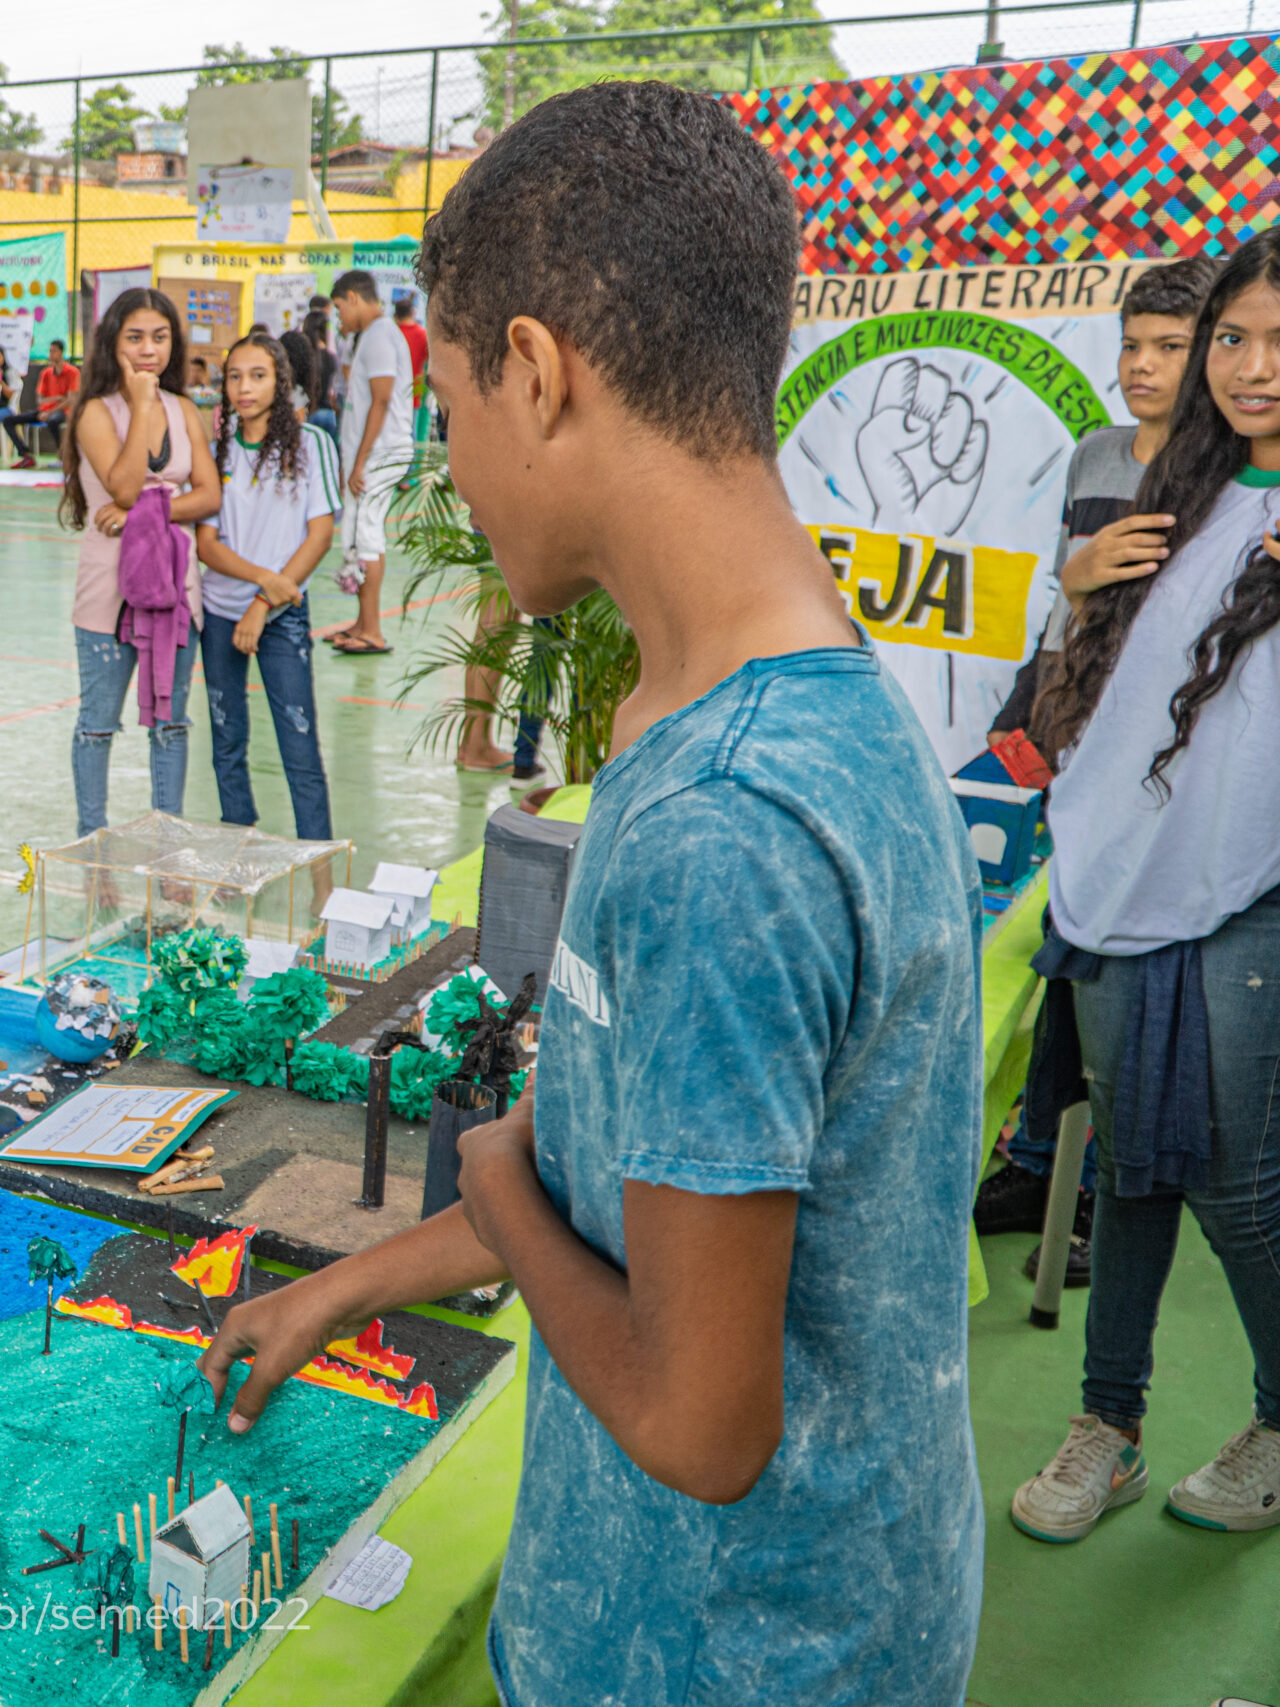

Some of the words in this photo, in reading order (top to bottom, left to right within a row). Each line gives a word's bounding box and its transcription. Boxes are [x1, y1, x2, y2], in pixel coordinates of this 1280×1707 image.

[185, 253, 193, 265] O
[201, 254, 252, 268] BRASIL
[260, 254, 286, 265] NAS
[299, 252, 341, 265] COPAS
[776, 342, 849, 441] STENCIA
[853, 330, 868, 364] E
[875, 316, 1025, 363] MULTIVOZES
[1023, 349, 1064, 392] DA
[820, 529, 975, 640] EJA
[126, 1125, 180, 1154] CAD
